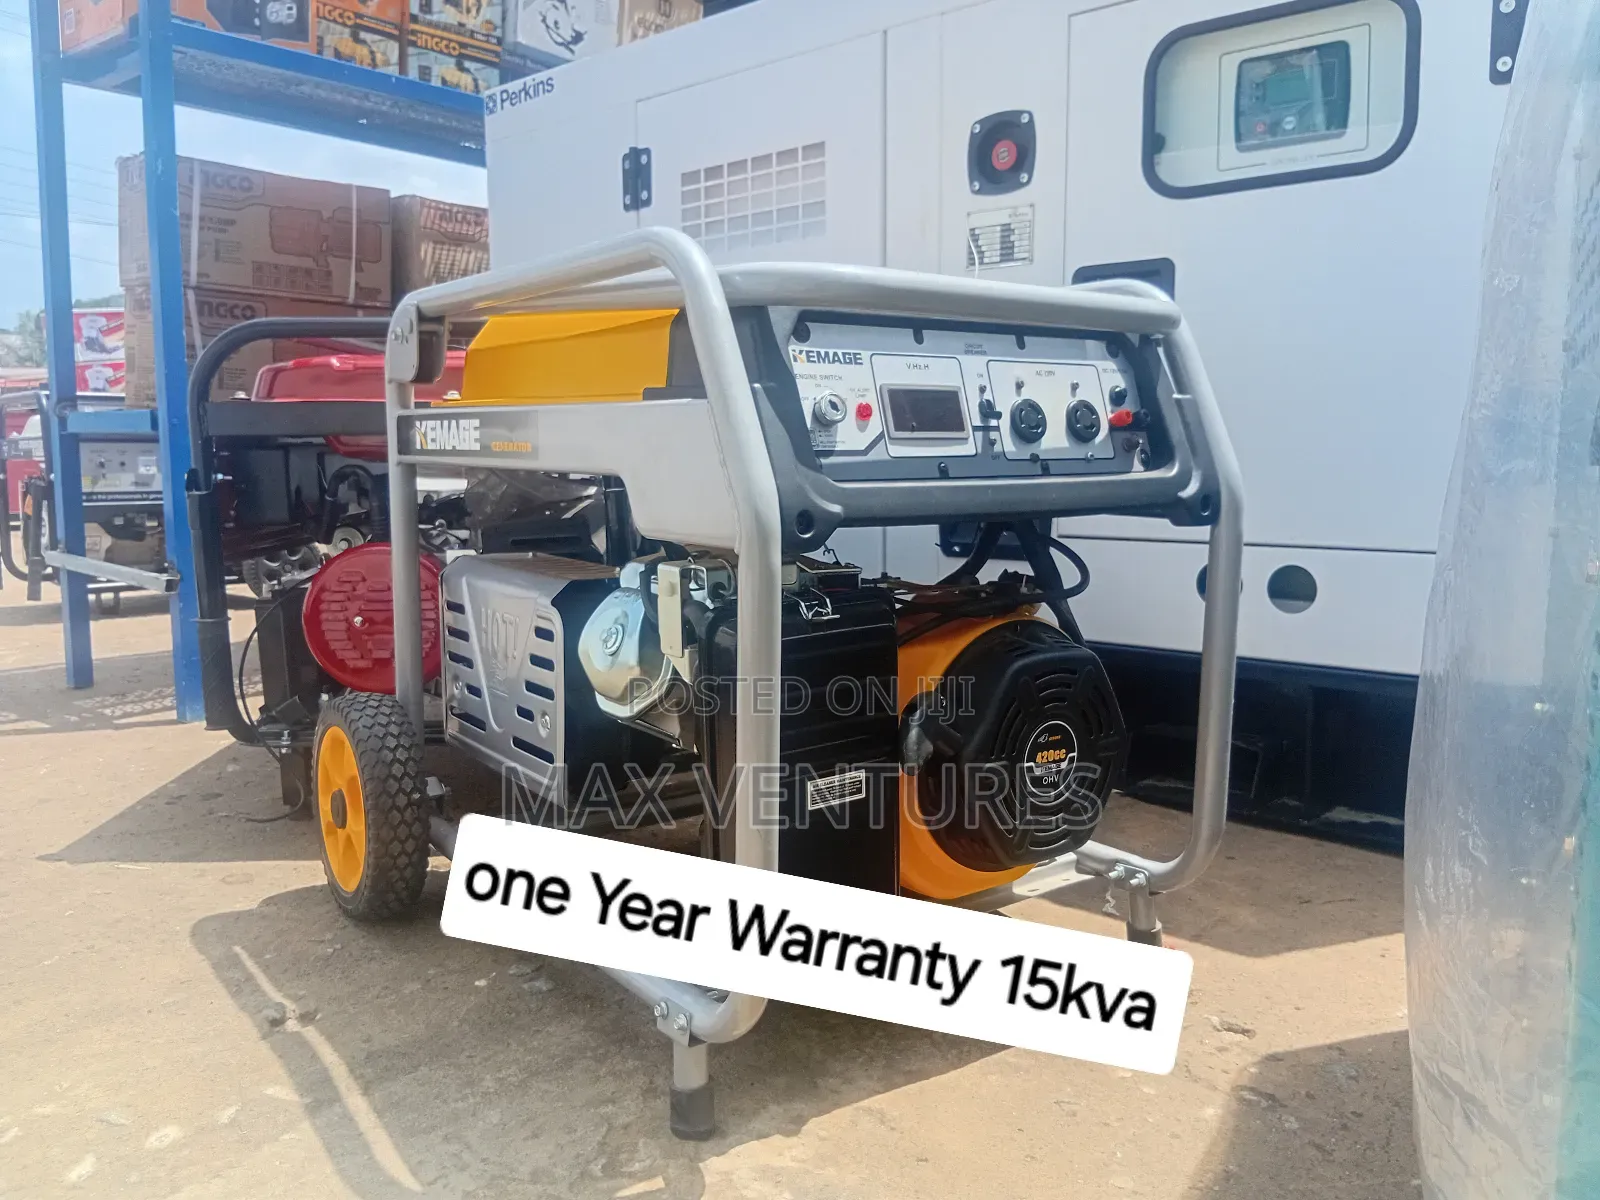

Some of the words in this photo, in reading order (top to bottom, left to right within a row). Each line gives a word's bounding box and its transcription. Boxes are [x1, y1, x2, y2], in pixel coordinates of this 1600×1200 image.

[500, 77, 555, 111] Perkins
[791, 349, 864, 366] KEMAGE
[415, 419, 481, 451] KEMAGE
[1035, 748, 1067, 763] 420cc
[1042, 773, 1060, 785] OHV
